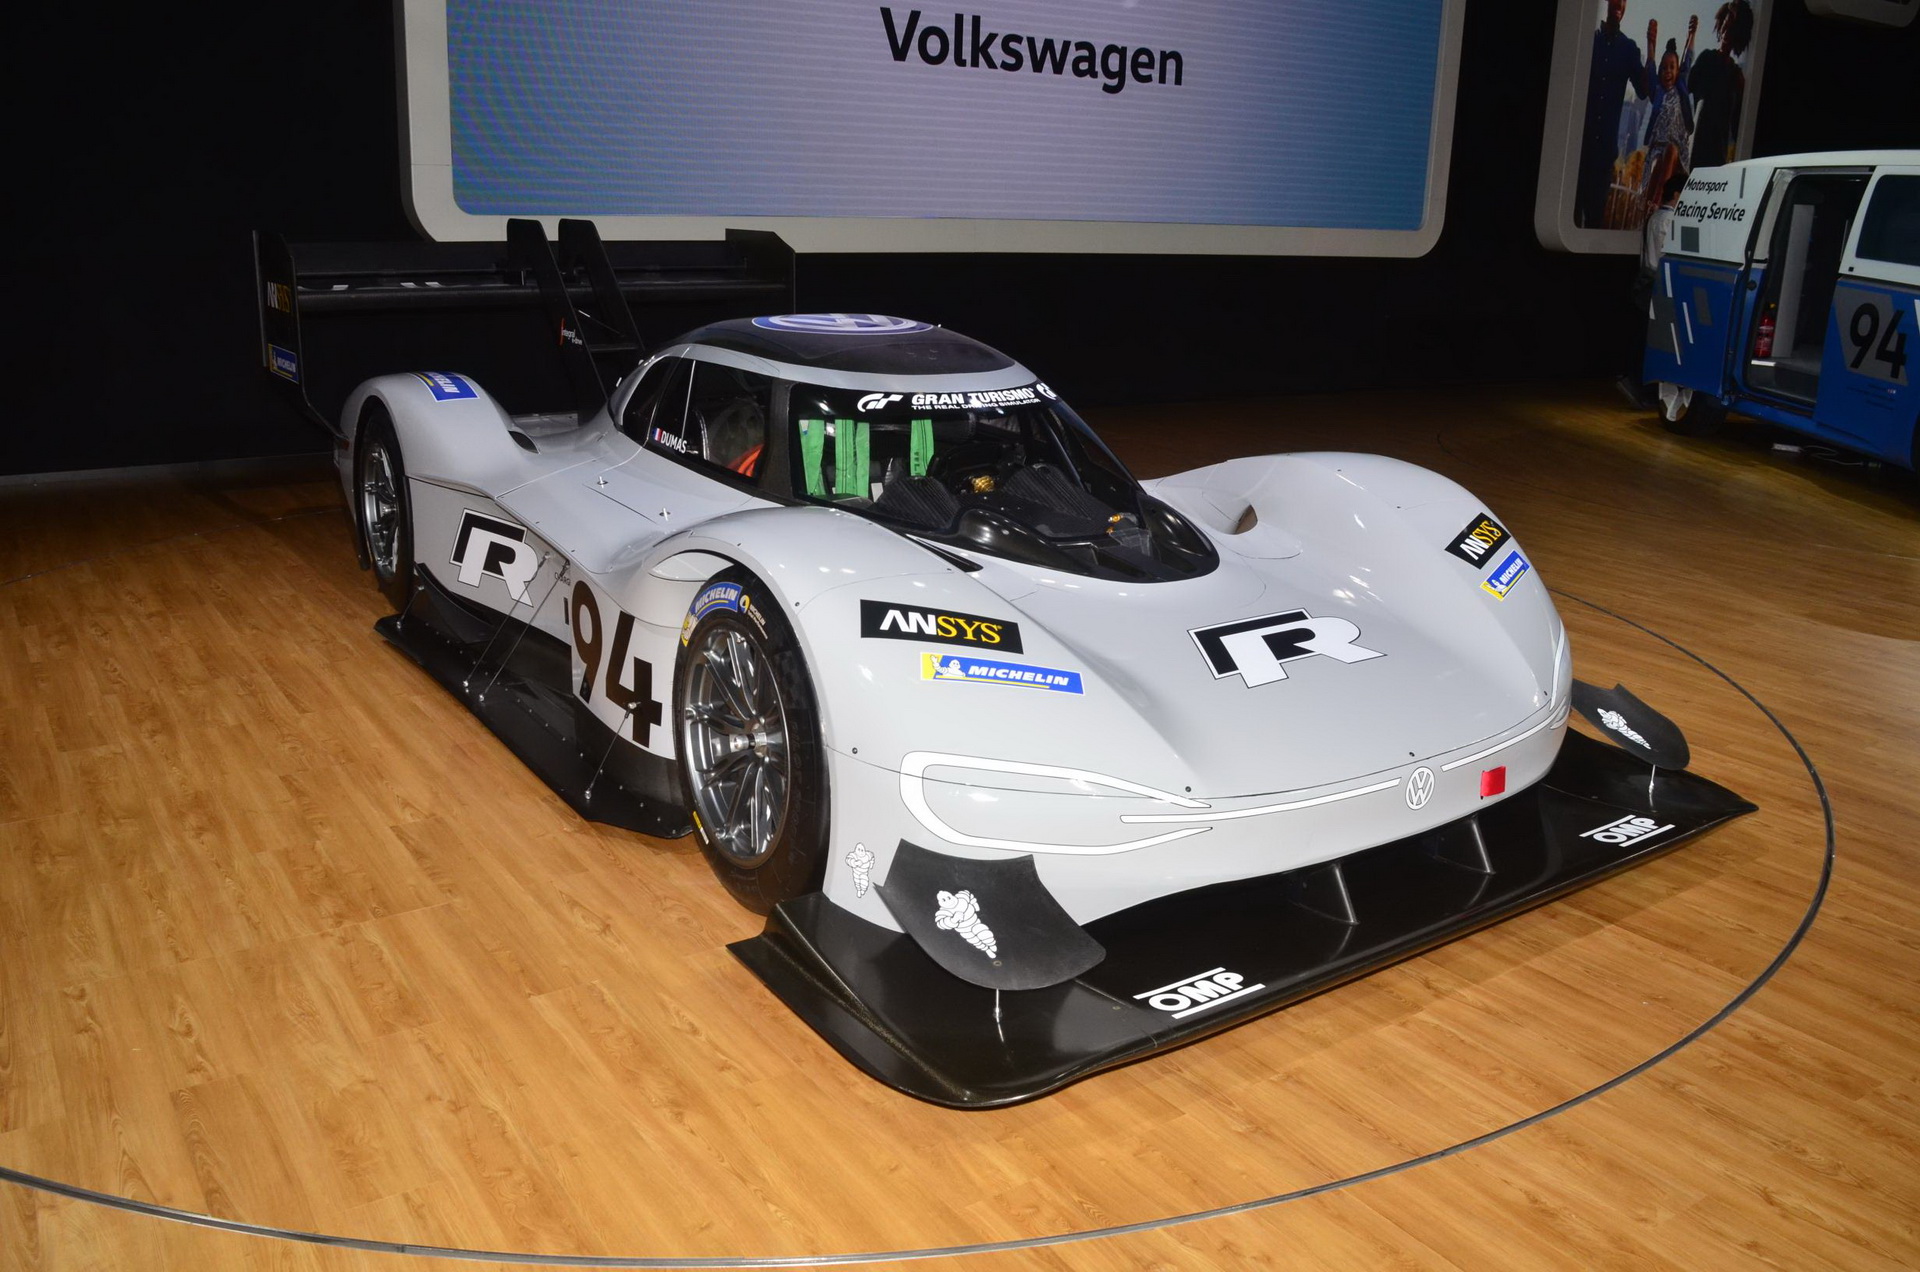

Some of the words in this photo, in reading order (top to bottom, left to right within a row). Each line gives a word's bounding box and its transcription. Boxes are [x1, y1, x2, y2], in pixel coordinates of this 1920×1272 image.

[880, 7, 1184, 94] Volkswagen
[1685, 179, 1728, 194] Motorsport
[1674, 201, 1708, 223] Racing
[1707, 202, 1746, 221] Service
[1850, 303, 1907, 379] 94
[911, 393, 964, 405] GRAN
[967, 387, 1036, 403] TURISMO
[999, 398, 1041, 407] SIMULATOR
[660, 430, 687, 454] DUMAS
[1460, 520, 1502, 560] ANSYS
[449, 507, 539, 608] R
[1499, 557, 1524, 585] MICHELIN
[695, 587, 738, 613] MICHELIN
[879, 609, 1001, 644] ANSYS
[1187, 607, 1388, 689] R
[968, 665, 1069, 686] MICHELIN
[1592, 816, 1660, 844] OMP
[1148, 971, 1245, 1012] OMP
